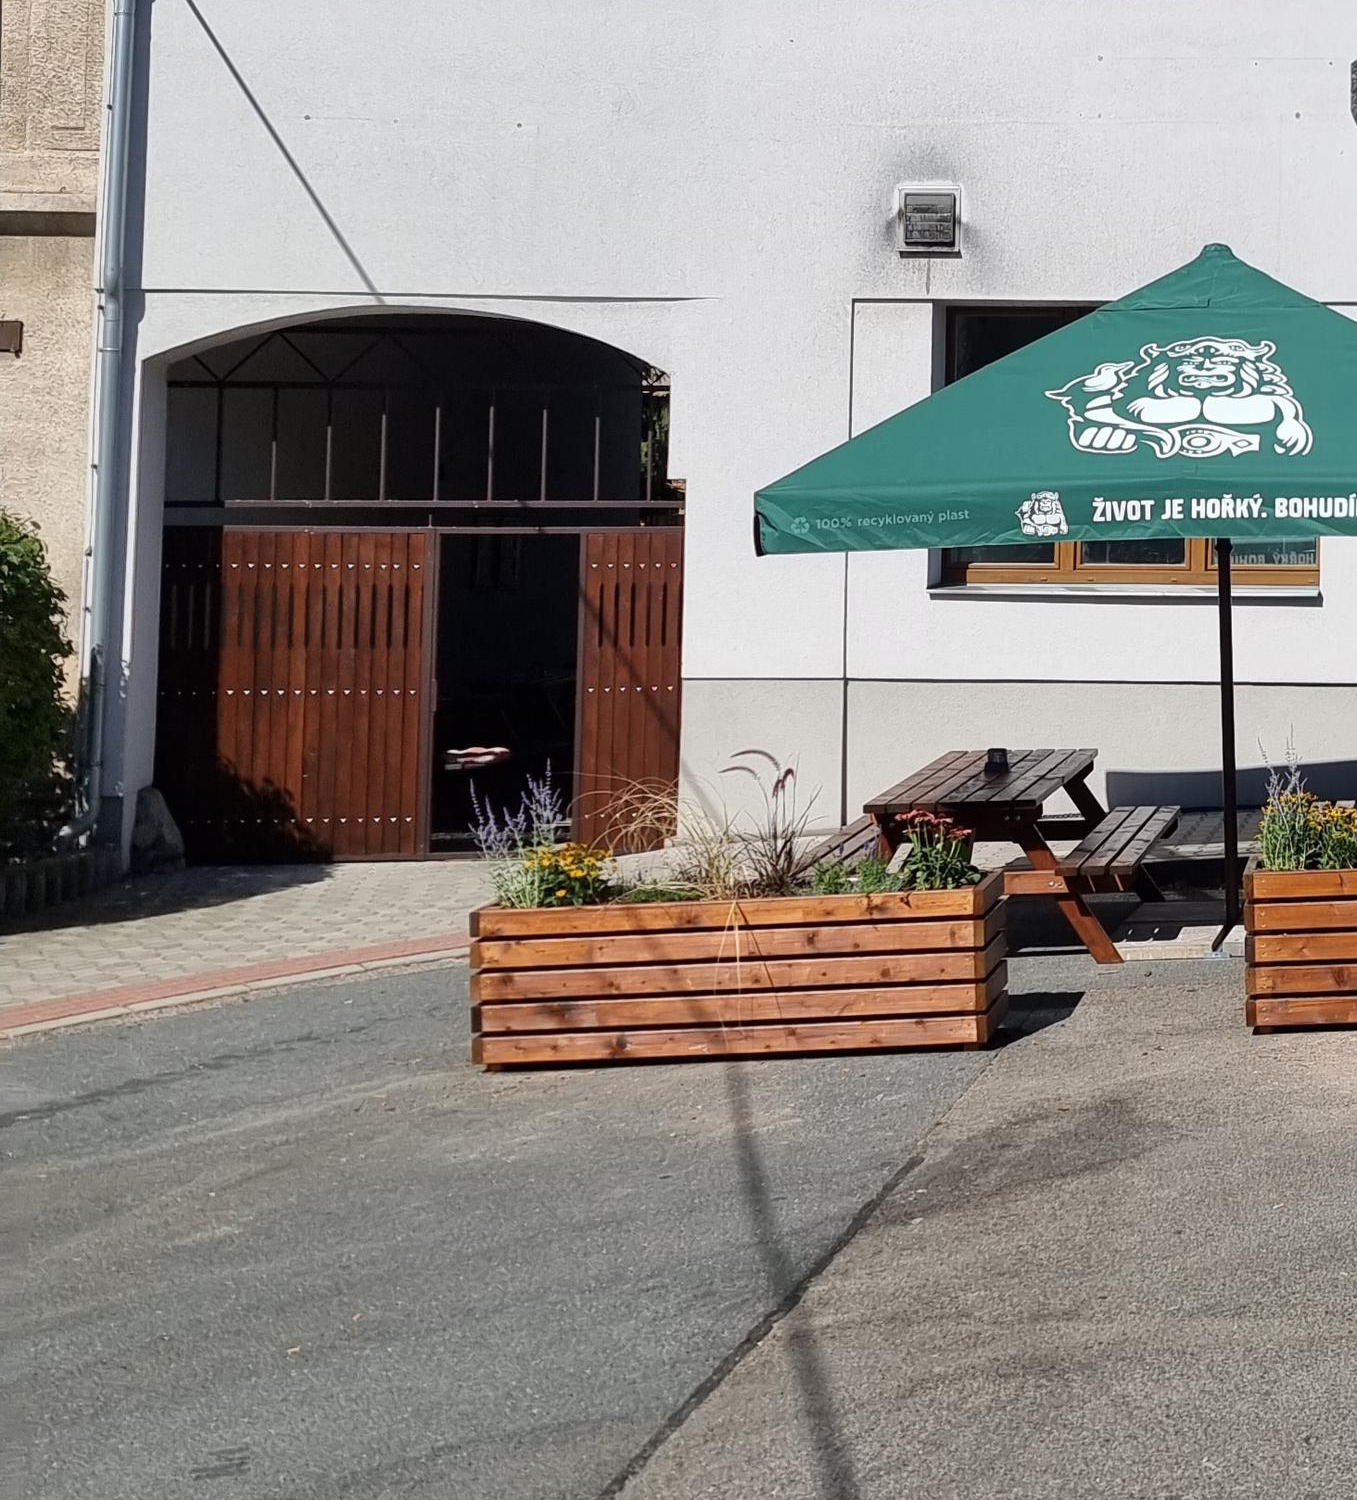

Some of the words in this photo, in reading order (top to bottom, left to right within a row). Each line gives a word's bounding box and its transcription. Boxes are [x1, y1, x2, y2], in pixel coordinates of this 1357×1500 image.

[815, 516, 851, 530] 100%
[857, 511, 934, 528] recyklovaný
[938, 508, 969, 524] plast
[1092, 496, 1155, 522] ŽIVOT
[1161, 498, 1184, 520] JE
[1191, 493, 1267, 519] HOŘKÝ.
